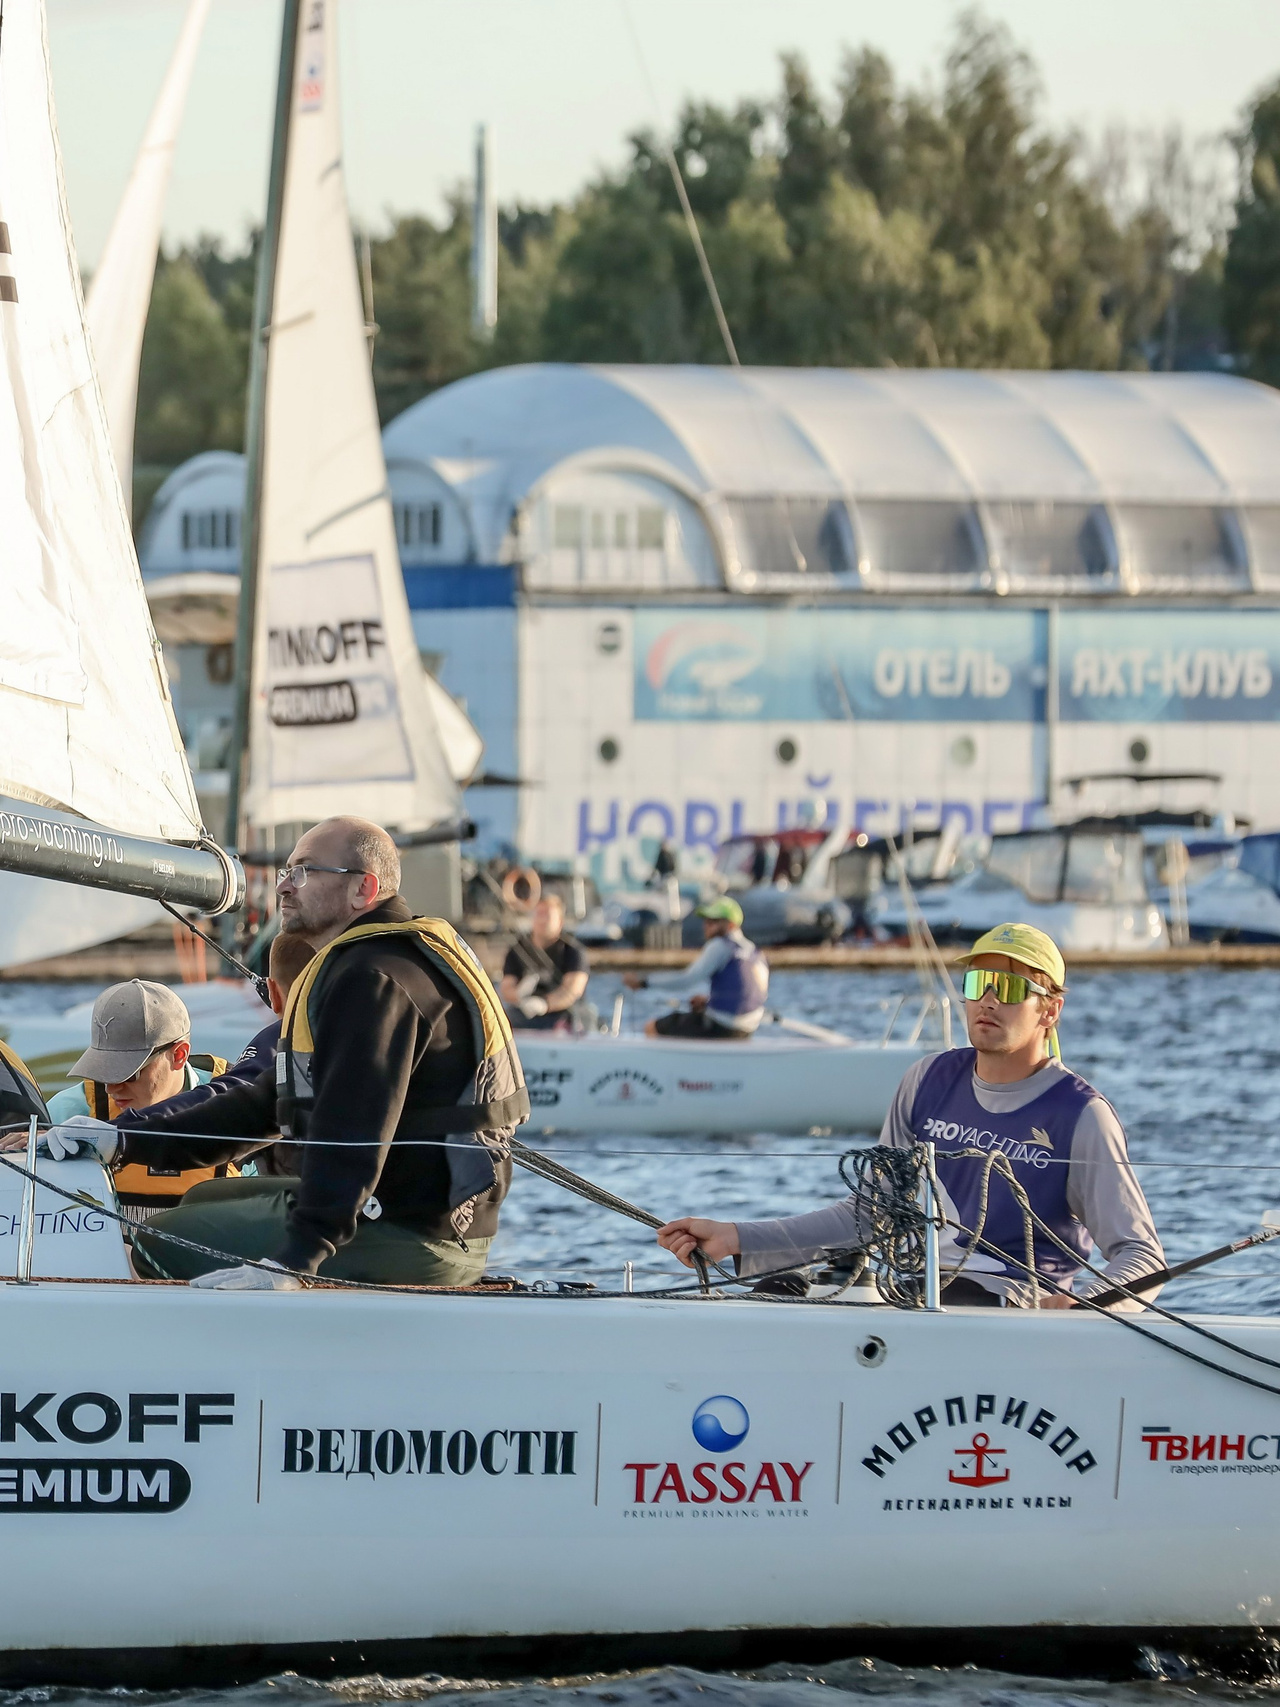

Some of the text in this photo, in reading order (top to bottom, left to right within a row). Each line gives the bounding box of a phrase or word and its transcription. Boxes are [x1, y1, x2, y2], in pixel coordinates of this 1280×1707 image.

[874, 647, 1012, 698] ОТЕЛЬ
[1072, 648, 1272, 699] ЯХТ-КЛУБ
[0, 812, 124, 868] pro-yachting.ru
[923, 1117, 1052, 1169] PROYACHTING
[281, 1427, 578, 1481] ВЕДОМОСТИ
[861, 1393, 1098, 1479] МОРПРИБОР
[623, 1461, 815, 1504] TASSAY
[1171, 1464, 1280, 1476] галерея интерьер
[623, 1509, 810, 1519] PREMIUM DRINKING WATER
[883, 1496, 1072, 1511] ЛЕГЕНДАРНЫЕ ЧАСЫ
